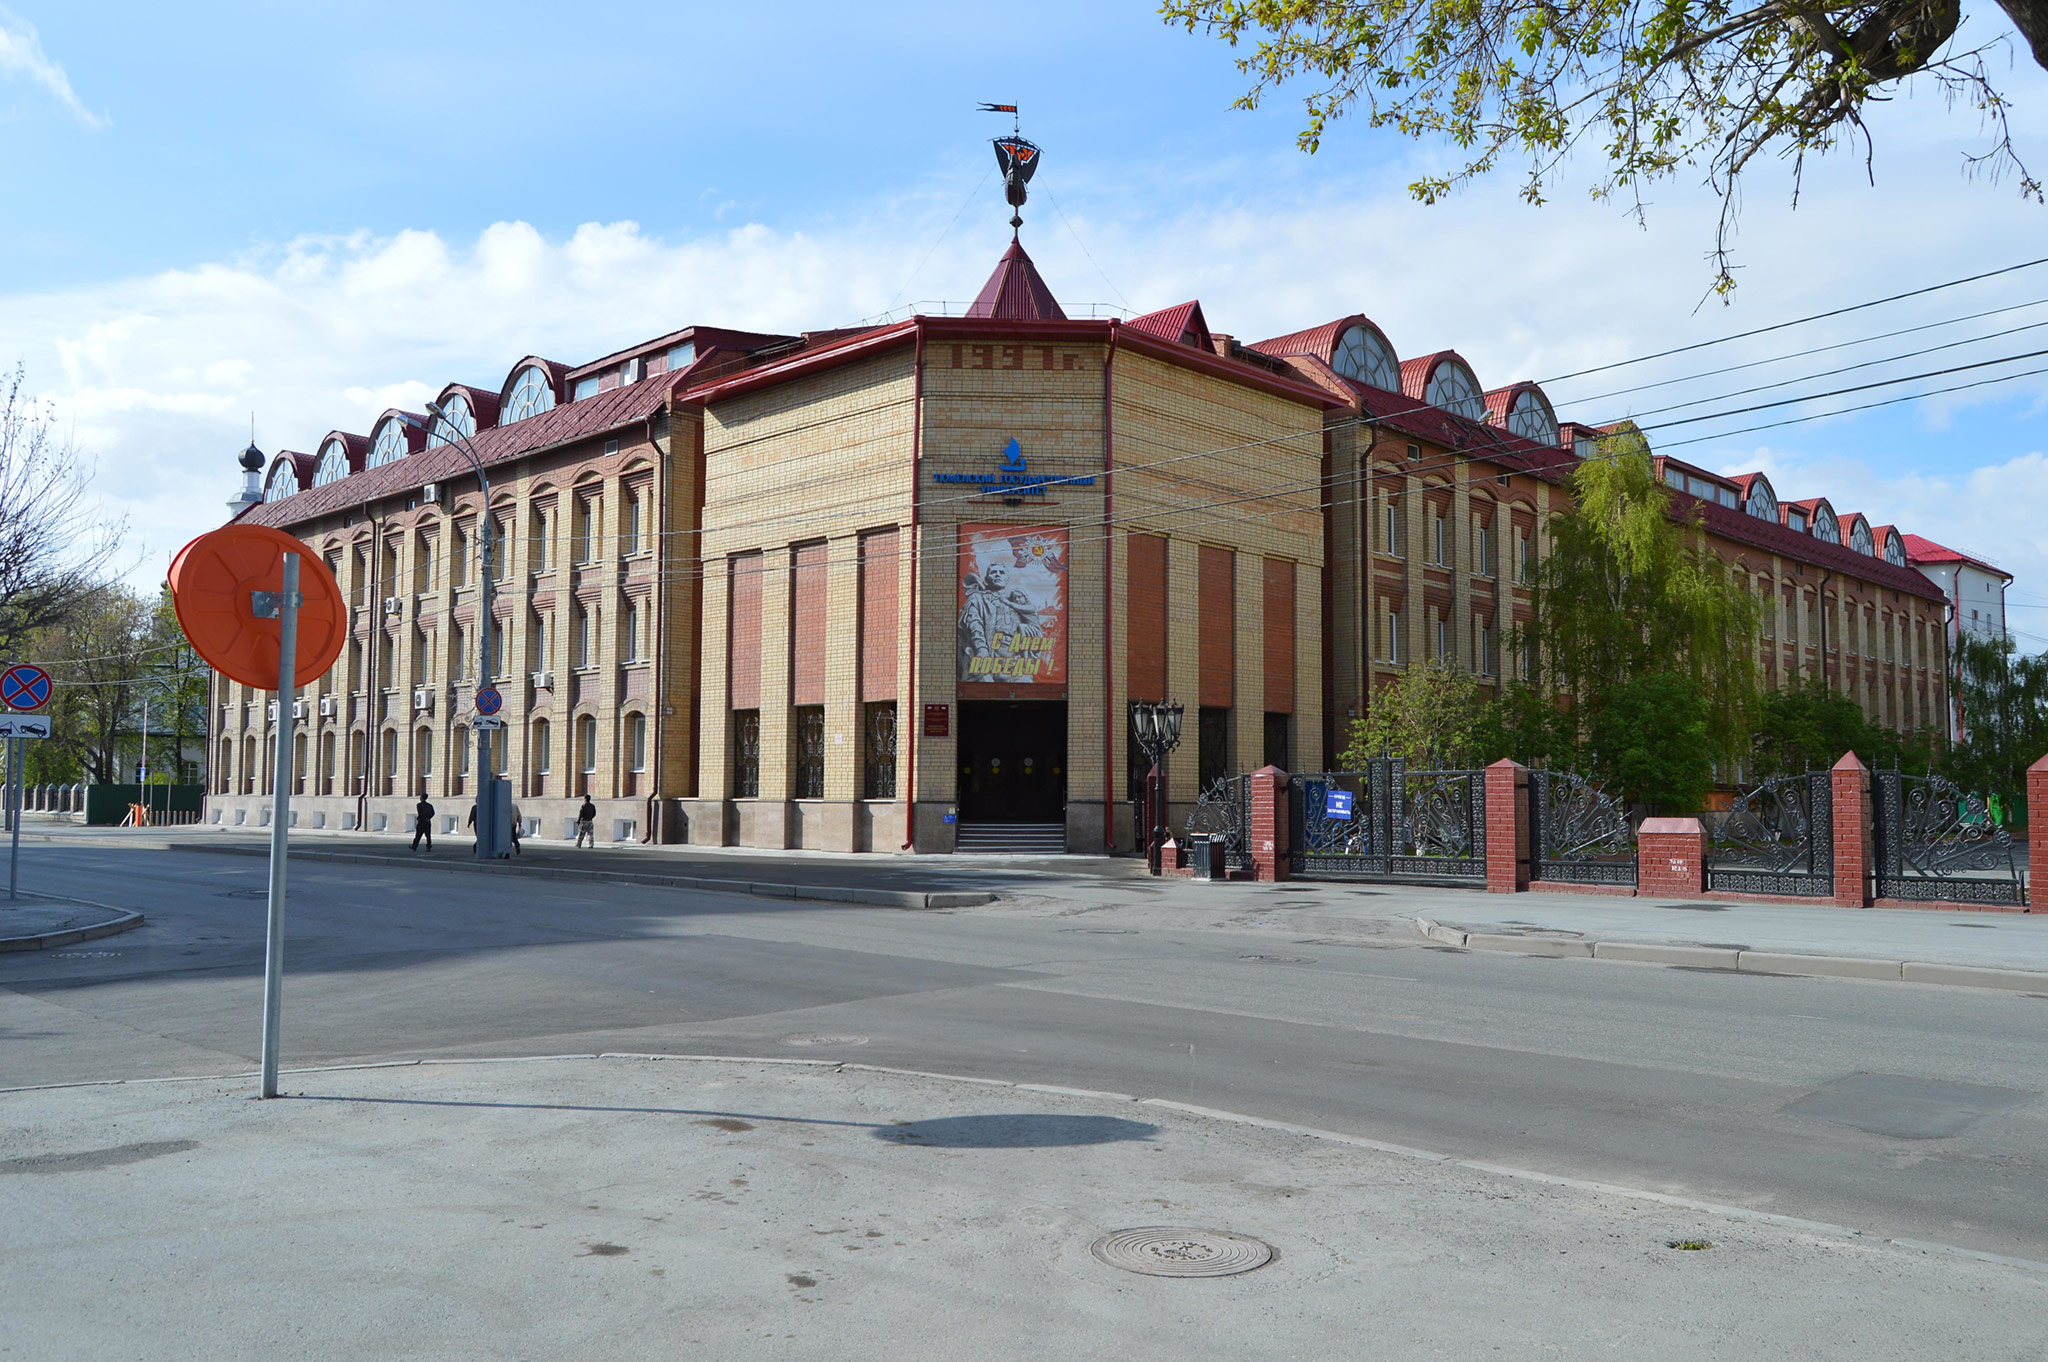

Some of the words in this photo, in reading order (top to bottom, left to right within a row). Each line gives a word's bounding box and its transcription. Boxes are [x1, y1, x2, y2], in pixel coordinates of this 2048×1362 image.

[934, 472, 996, 484] ТЮМЕНСКИЙ
[999, 474, 1095, 486] ГОСУДАРСТВЕННЫЙ
[980, 485, 1048, 496] УНИВЕРСИТЕТ
